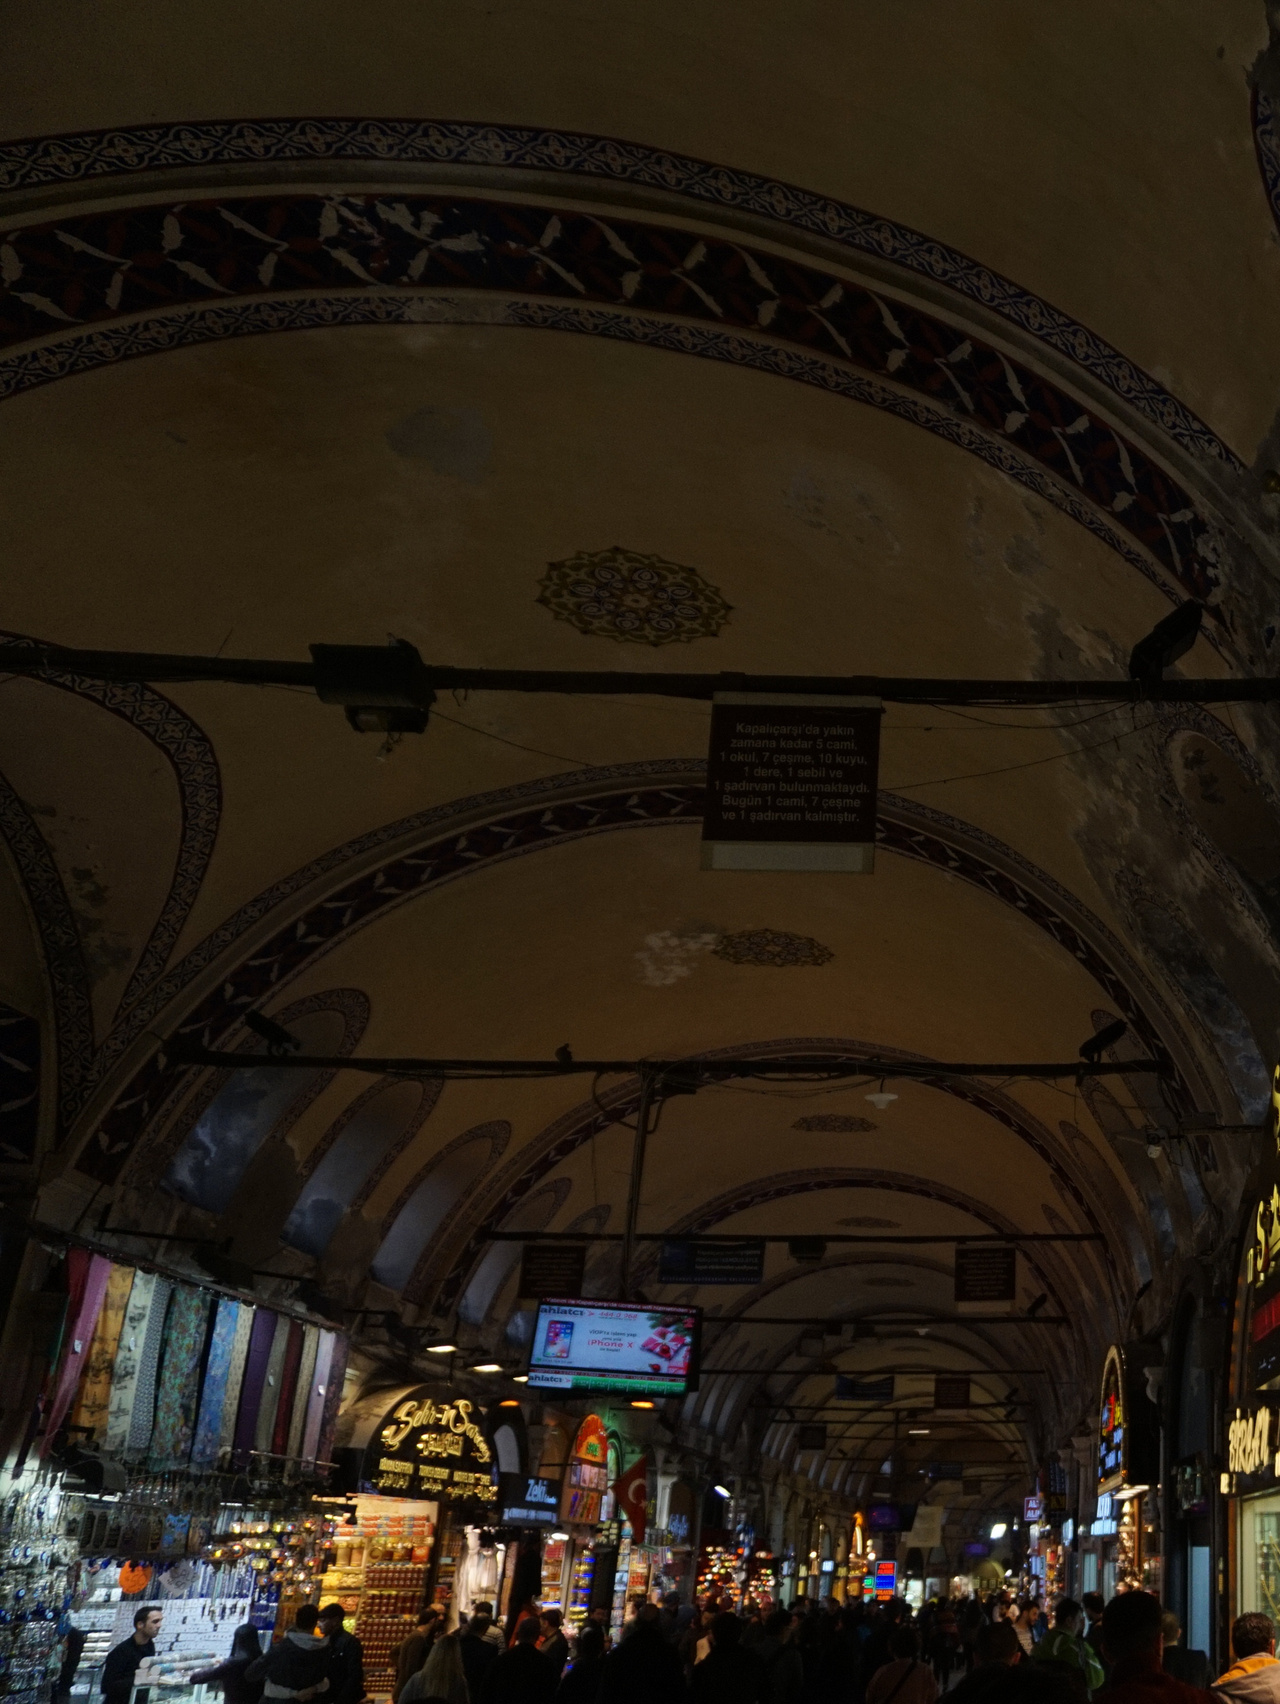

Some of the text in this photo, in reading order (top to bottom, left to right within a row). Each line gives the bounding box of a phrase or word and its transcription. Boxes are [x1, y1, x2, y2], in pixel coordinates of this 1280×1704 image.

[735, 722, 855, 738] Kapalıçarşı'da yakın
[730, 739, 776, 749] zamana
[780, 738, 813, 749] kadar
[816, 739, 823, 749] 5
[720, 752, 725, 762] 1
[730, 752, 759, 764] okul,
[762, 752, 769, 762] 7
[773, 754, 814, 766] çeşme,
[819, 753, 832, 763] 10
[743, 767, 749, 777] 1
[787, 767, 793, 777] 1
[797, 767, 826, 778] sebil
[829, 769, 843, 778] ve
[714, 781, 870, 795] 1 şadırvan bulunmaktaydı.
[723, 795, 762, 808] Bugün
[766, 796, 771, 806] 1
[811, 796, 818, 806] 7
[822, 798, 861, 809] çeşme
[721, 811, 860, 824] ve 1 şadırvan kalmıştır.
[540, 1305, 585, 1316] ahlatcı
[588, 1339, 624, 1348] iPhone
[528, 1374, 563, 1384] ahlatcı
